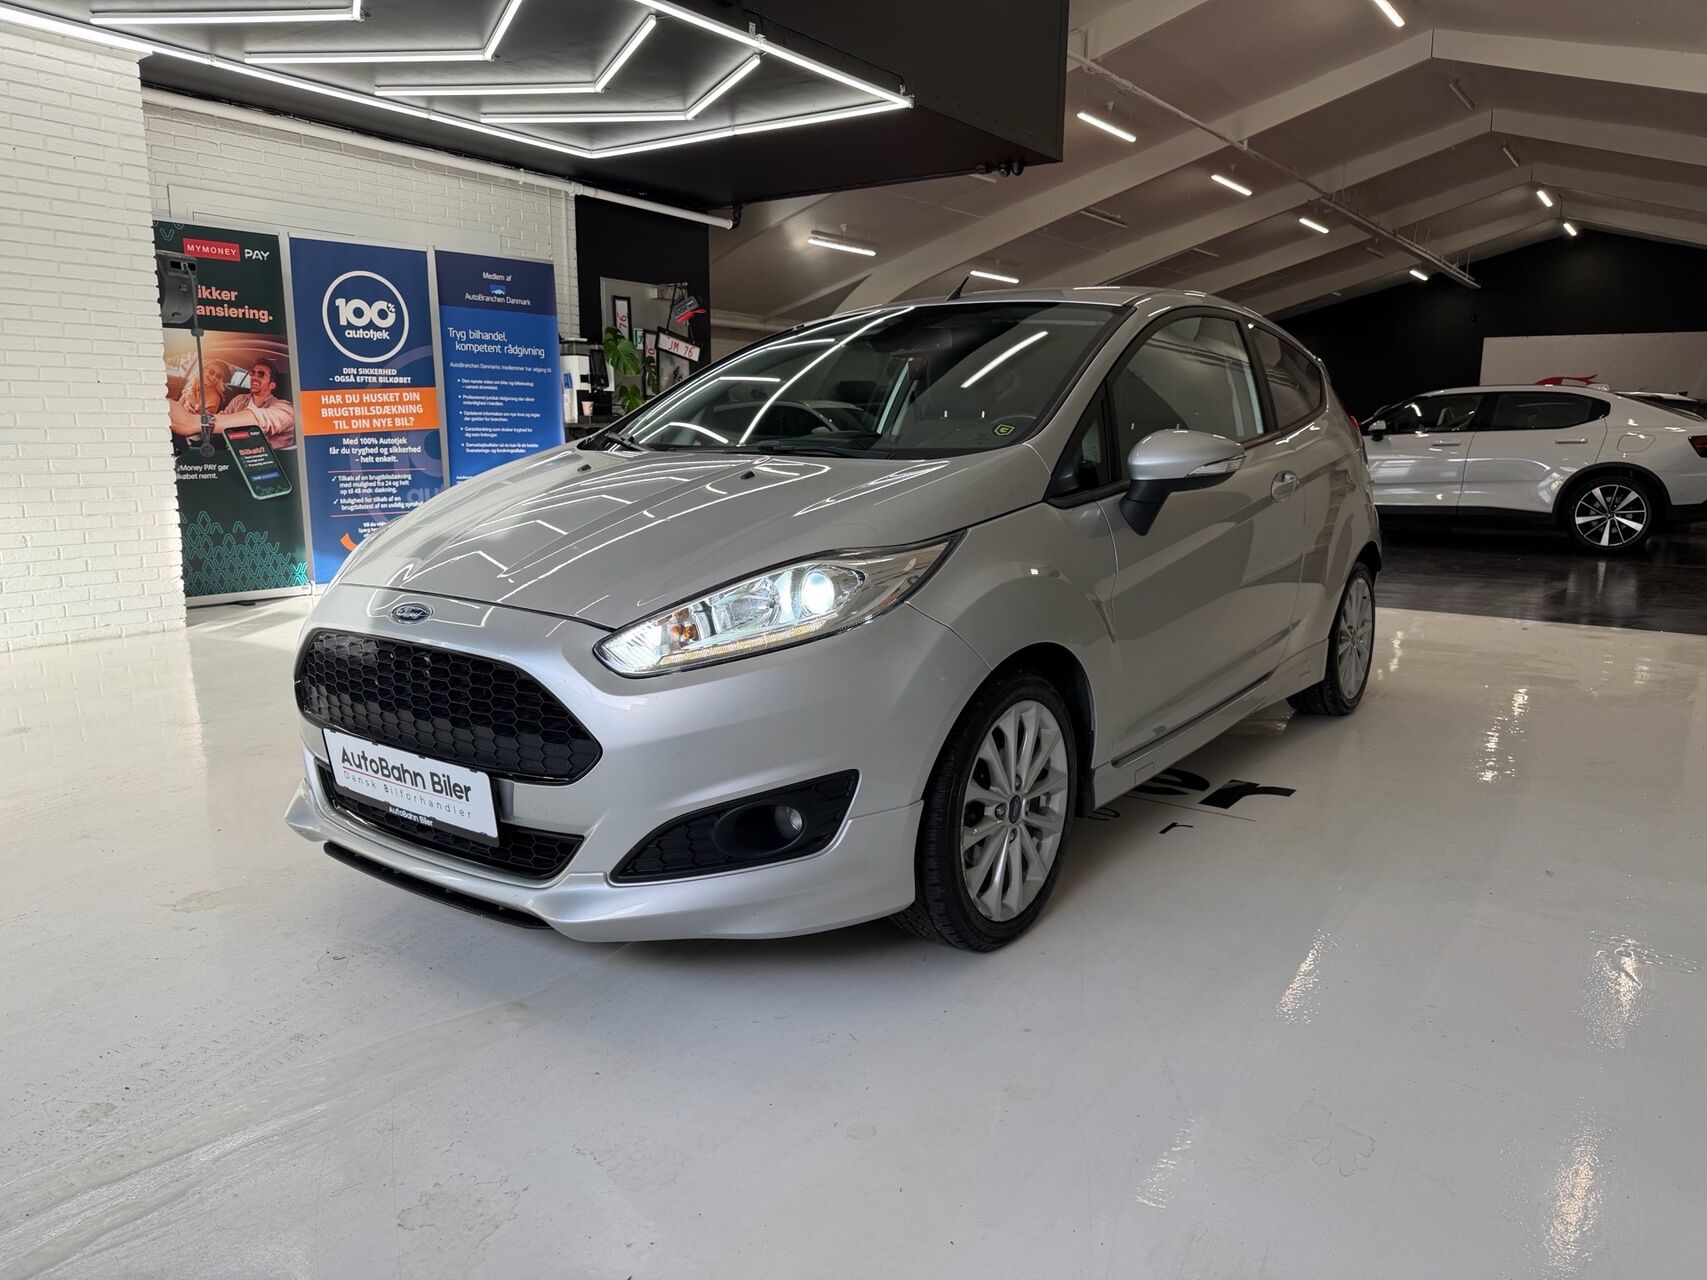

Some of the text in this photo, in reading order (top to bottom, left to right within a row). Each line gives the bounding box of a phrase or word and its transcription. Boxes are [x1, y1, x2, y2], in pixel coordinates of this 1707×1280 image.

[187, 244, 270, 260] MYMONEY PAY
[482, 272, 505, 281] Medlem
[197, 285, 238, 301] ikker
[465, 292, 531, 306] AutoBranchen Danmark
[195, 303, 273, 324] ansiering.
[345, 329, 390, 341] autotjek
[447, 327, 508, 342] Tryg bilhandel,
[455, 341, 545, 359] kompetent rådgivning
[684, 345, 695, 358] 76
[358, 368, 397, 376] SIKKERHED
[334, 375, 355, 383] OGSÅ
[378, 376, 412, 384] BILKØBET
[321, 392, 421, 404] HAR DU HUSKET DIN
[321, 404, 423, 418] BRUGTBILSDÆKNING
[333, 417, 415, 430] TIL DIN NYE BIL?
[360, 437, 378, 445] 100%
[379, 437, 408, 446] Autotjek
[351, 446, 378, 456] tryghed
[379, 447, 388, 455] og
[389, 446, 422, 454] sikkerhed
[375, 455, 398, 463] enkelt.
[342, 746, 472, 802] AutoBahn Biler
[343, 770, 472, 819] Dansk Bilforhandler
